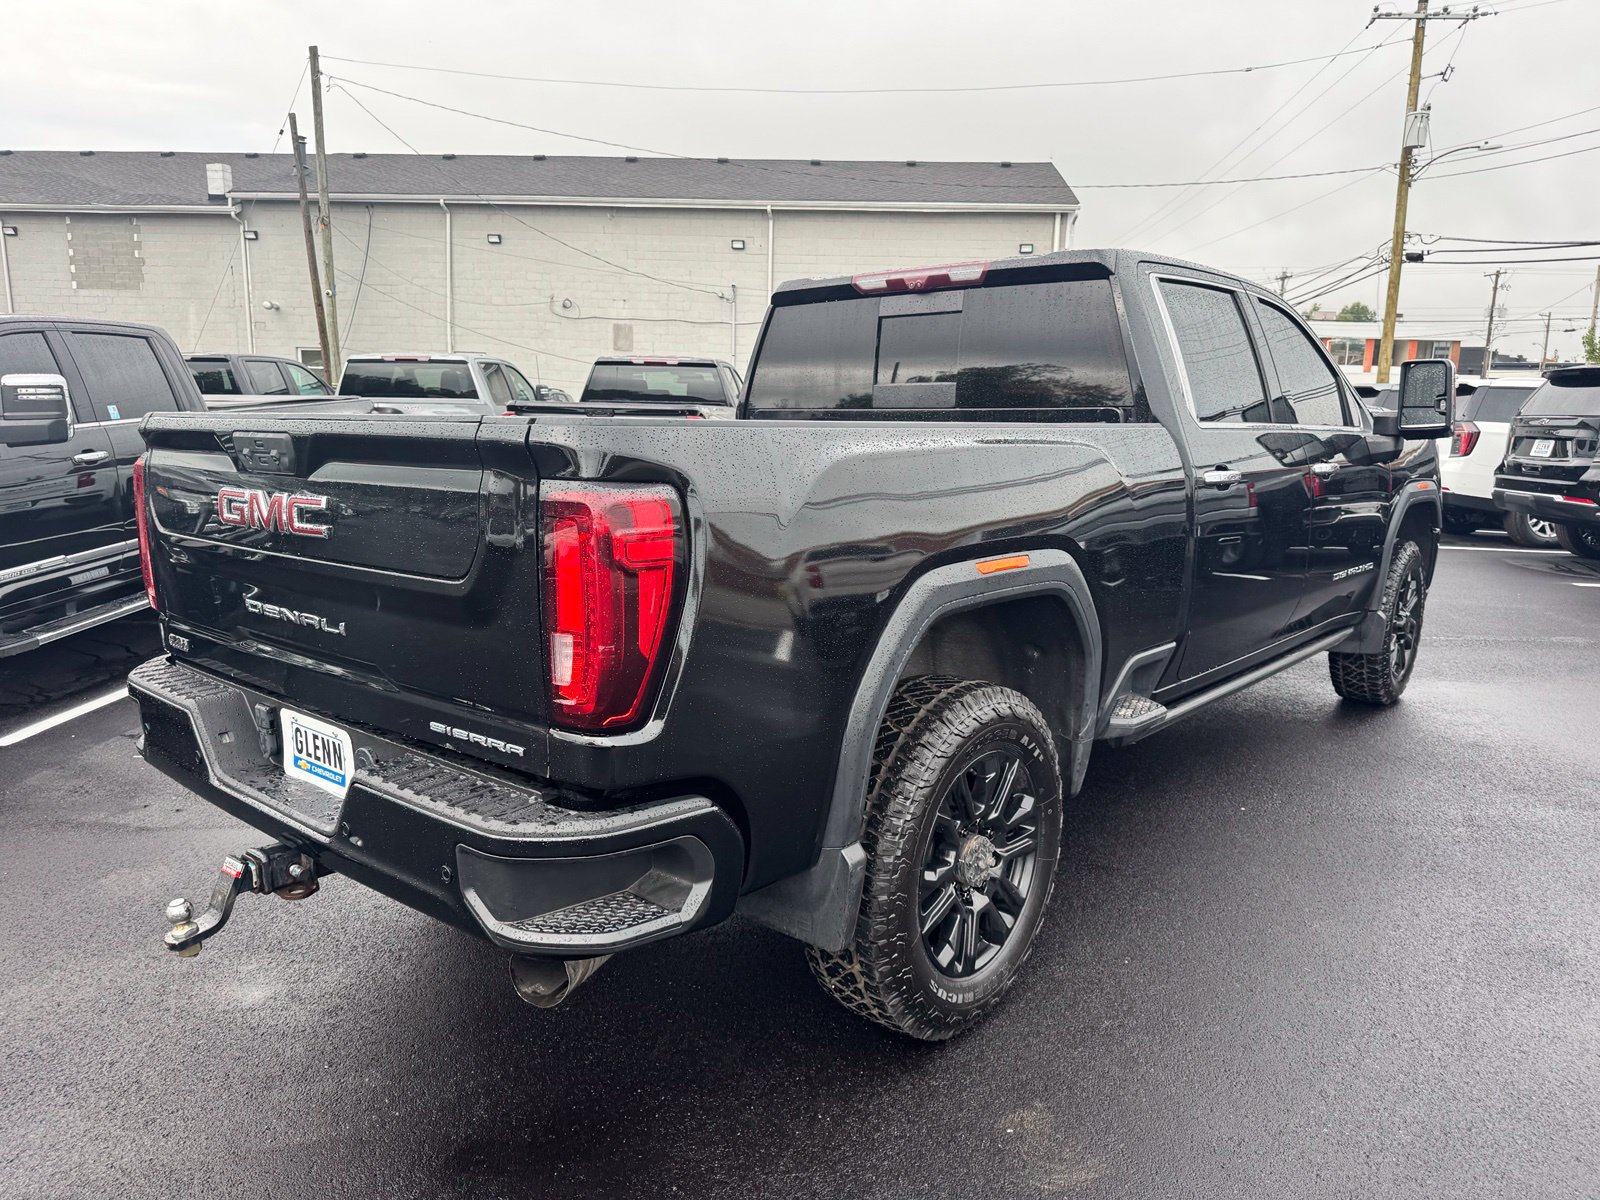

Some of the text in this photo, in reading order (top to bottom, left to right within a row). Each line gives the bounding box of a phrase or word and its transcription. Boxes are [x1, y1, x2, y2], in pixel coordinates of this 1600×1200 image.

[217, 487, 332, 539] GMC
[245, 598, 346, 636] DENALI
[295, 727, 343, 771] GLENN
[430, 721, 525, 757] SIERRA
[311, 765, 342, 783] CHEVROLET
